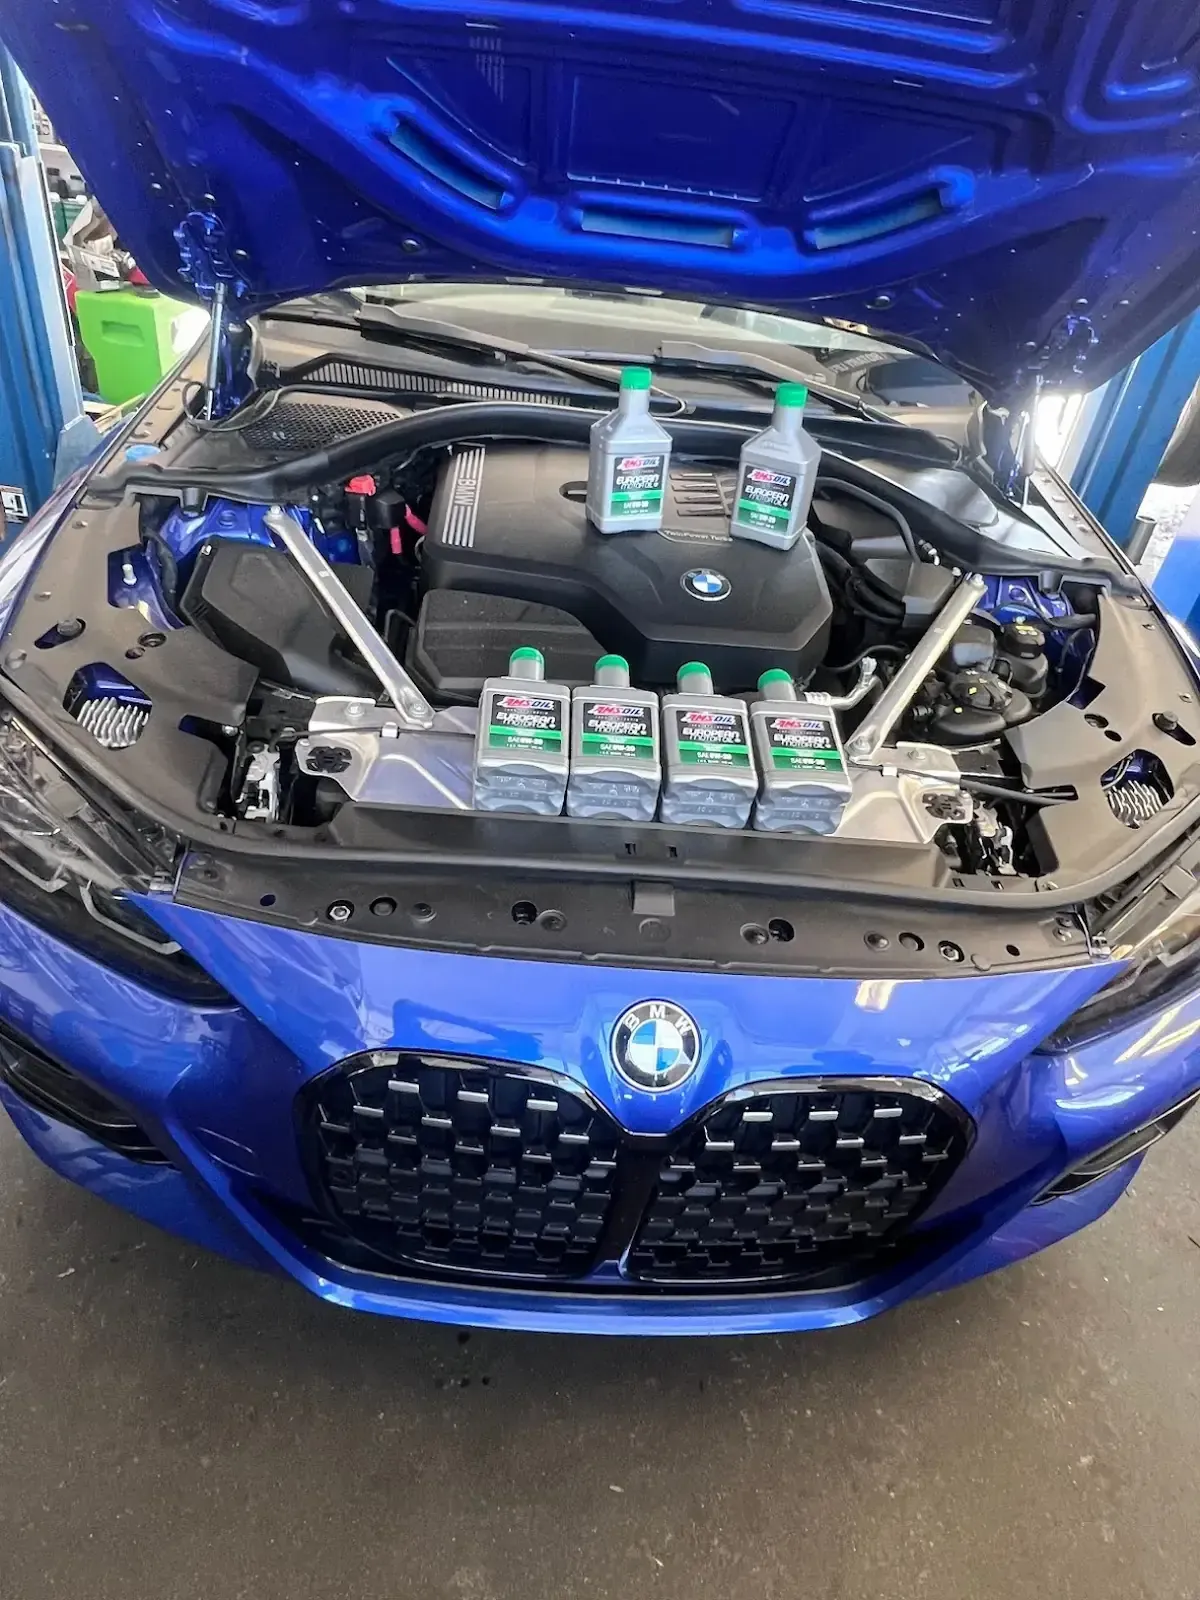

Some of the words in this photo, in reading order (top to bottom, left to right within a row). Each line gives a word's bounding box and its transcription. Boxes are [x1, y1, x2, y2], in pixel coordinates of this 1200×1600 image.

[618, 457, 660, 470] AMSOIL
[616, 474, 660, 485] EUROPEAN
[747, 469, 791, 486] AMSOIL
[454, 479, 476, 505] BMW
[745, 485, 790, 502] EUROPEAN
[500, 697, 554, 709] AMSOIL
[590, 705, 644, 717] AMSOIL
[496, 712, 556, 724] EUROPEAN
[684, 712, 736, 725] AMSOIL
[503, 720, 536, 729] MOTOR
[588, 719, 647, 730] EUROPEAN
[772, 719, 825, 731] AMSOIL
[682, 727, 740, 739] EUROPEAN
[774, 734, 830, 744] EUROPEAN
[623, 1004, 692, 1036] BMW
